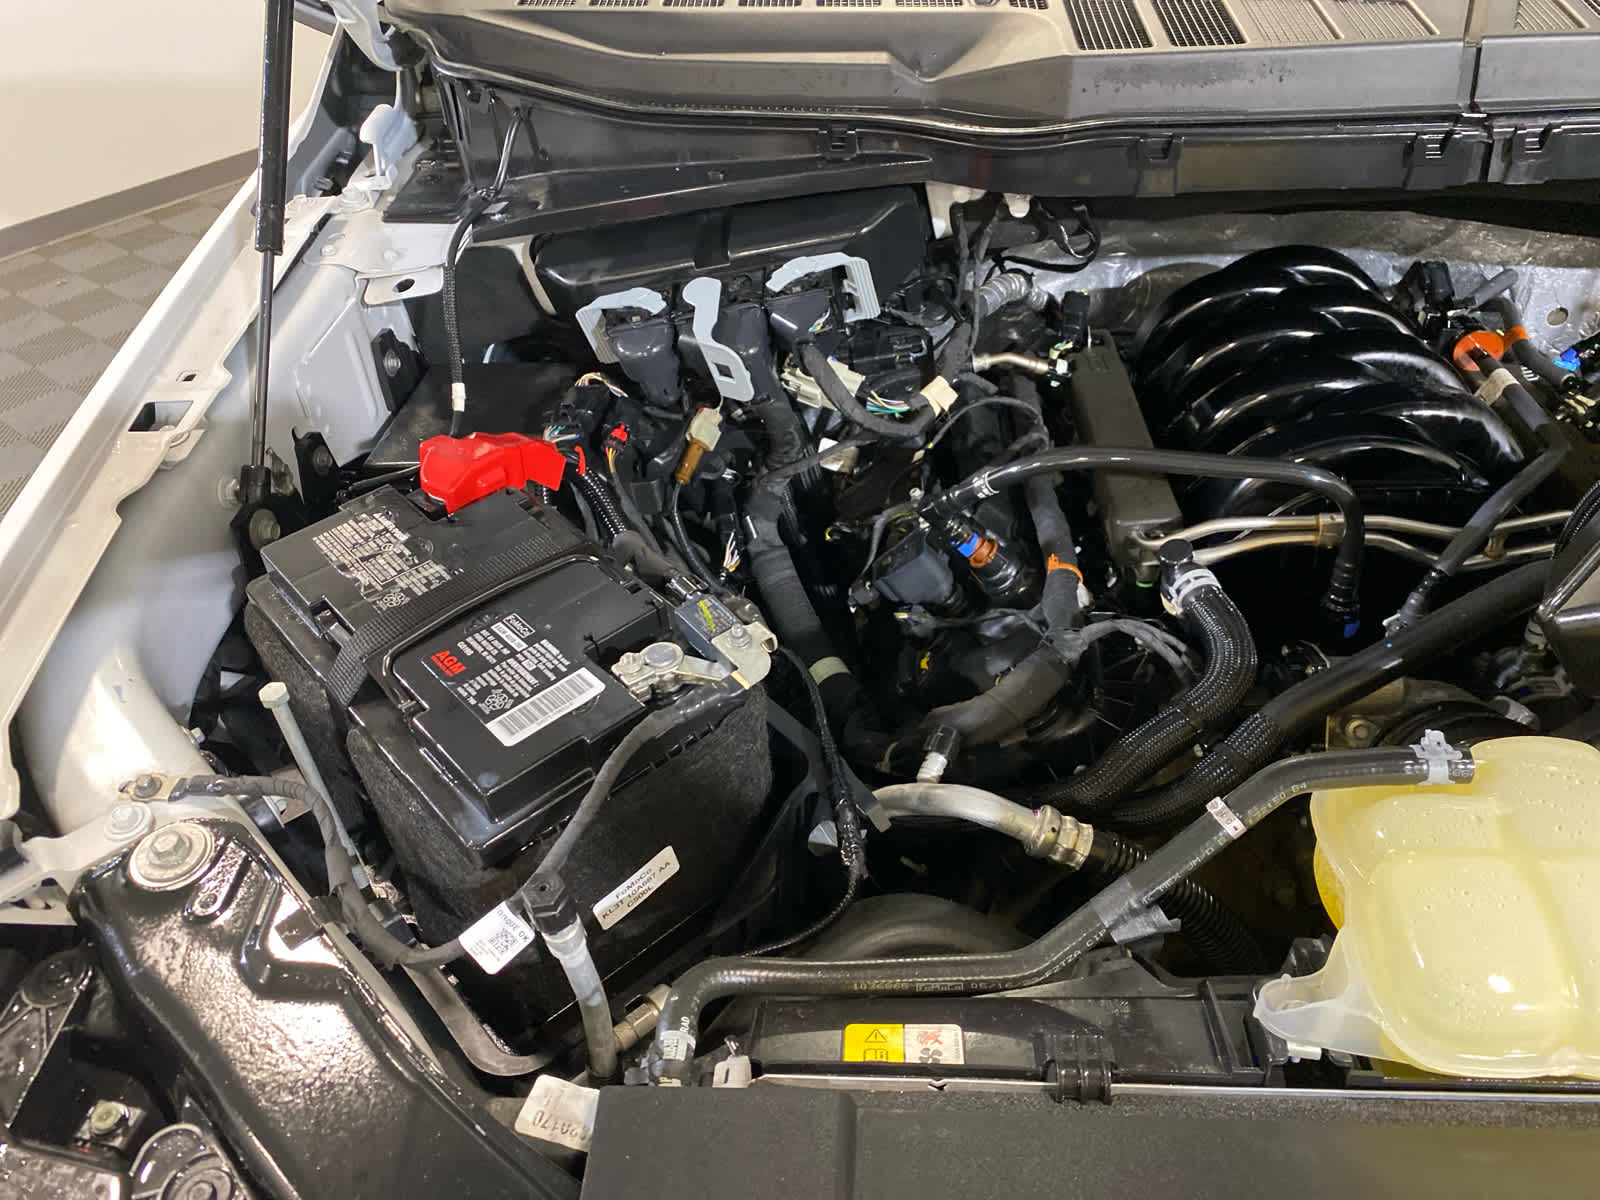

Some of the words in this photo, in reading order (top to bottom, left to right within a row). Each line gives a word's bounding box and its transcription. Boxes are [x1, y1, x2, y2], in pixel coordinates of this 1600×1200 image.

[506, 615, 531, 637] FoMoCo
[436, 650, 467, 675] AGM
[659, 862, 670, 873] AA
[616, 868, 652, 899] FoMoCo
[680, 1016, 690, 1032] RAD
